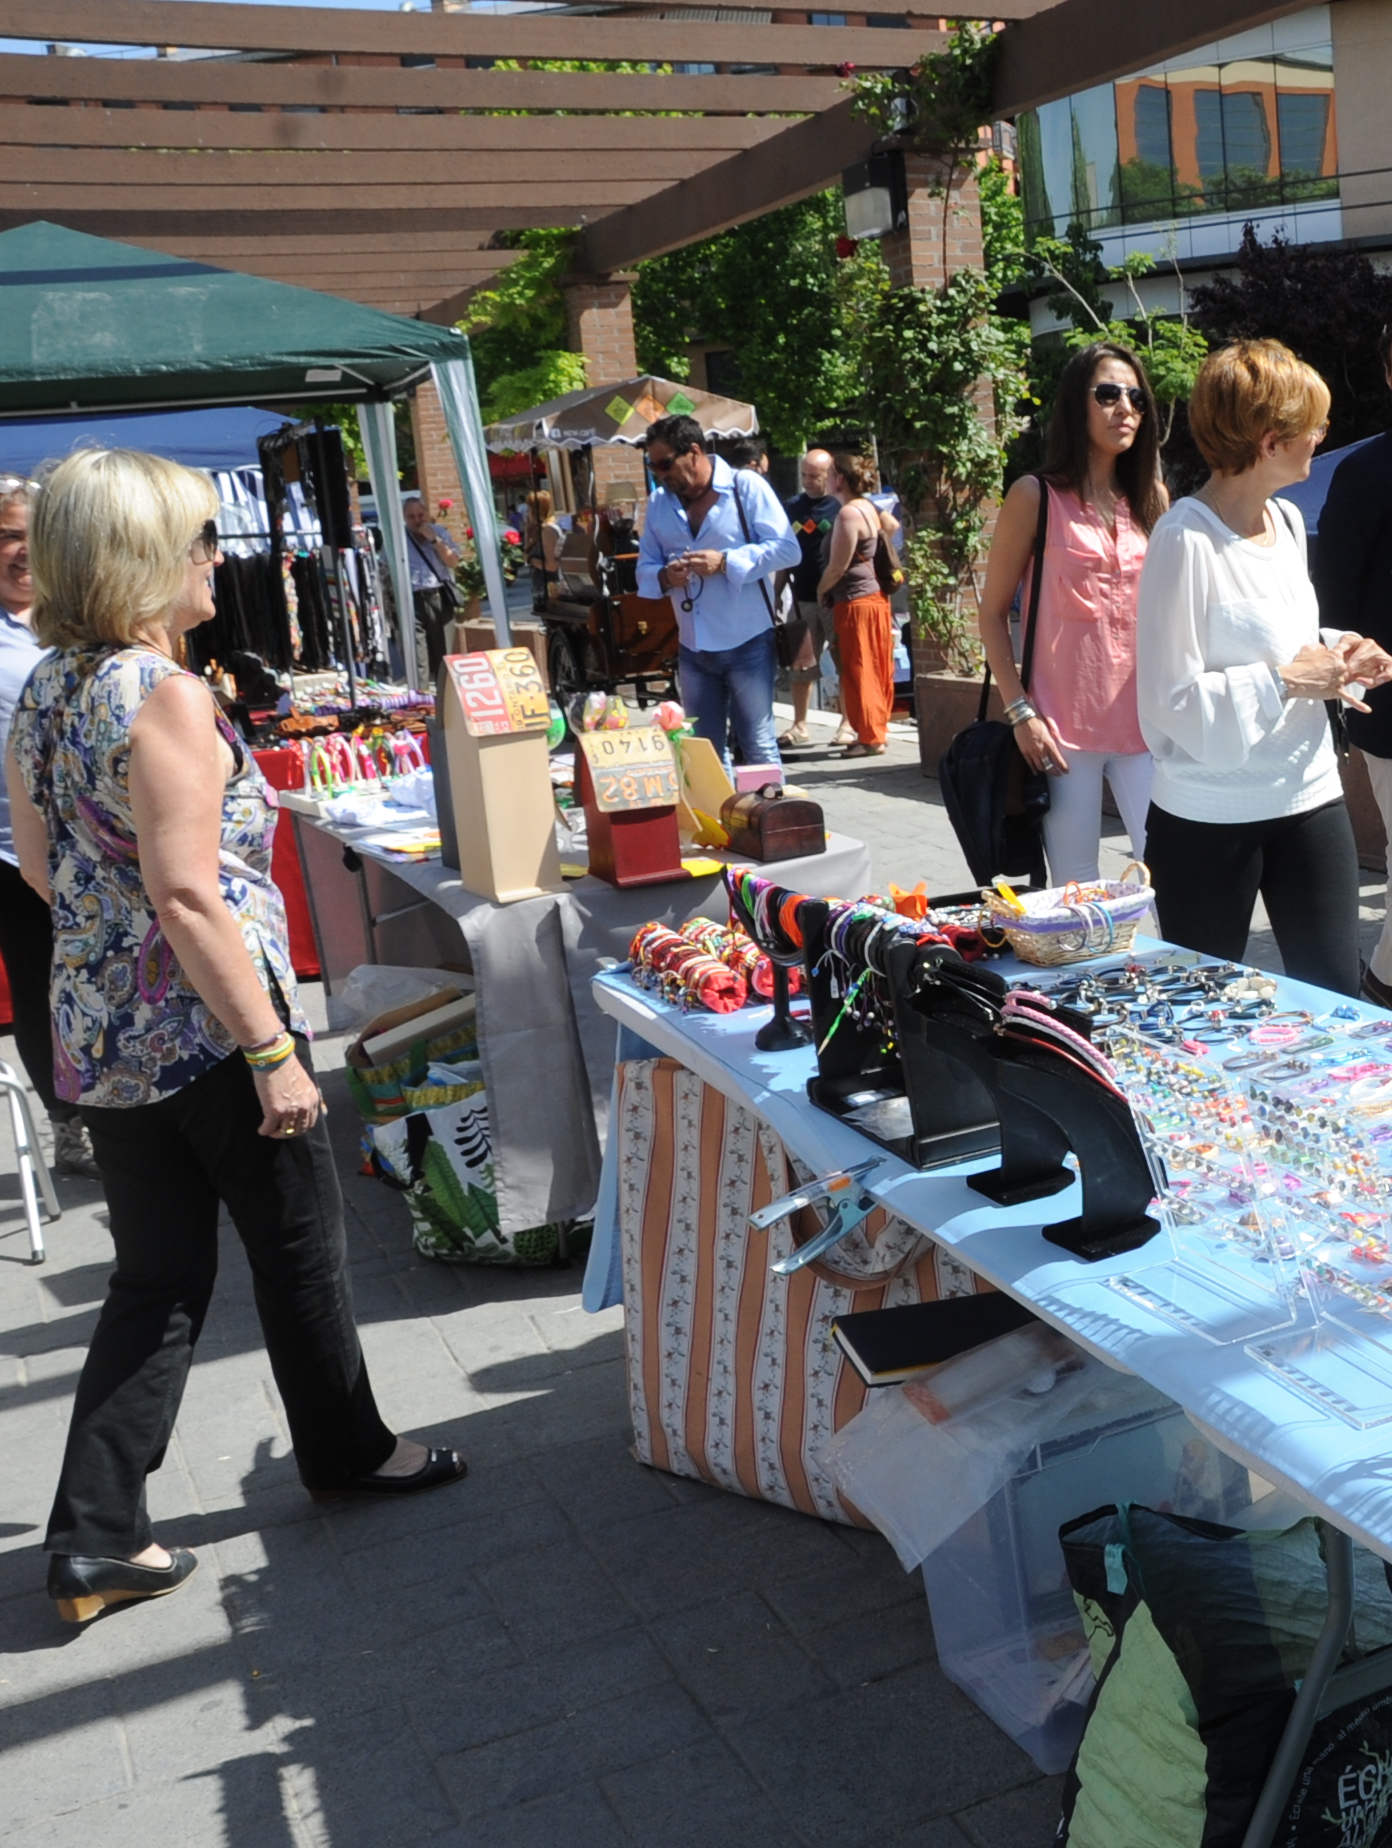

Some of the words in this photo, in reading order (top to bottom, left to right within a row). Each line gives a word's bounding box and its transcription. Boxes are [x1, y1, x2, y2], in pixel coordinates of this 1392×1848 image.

[452, 657, 505, 718] 1260
[601, 735, 665, 755] 9140
[1302, 1766, 1314, 1786] una
[1336, 1726, 1347, 1741] al
